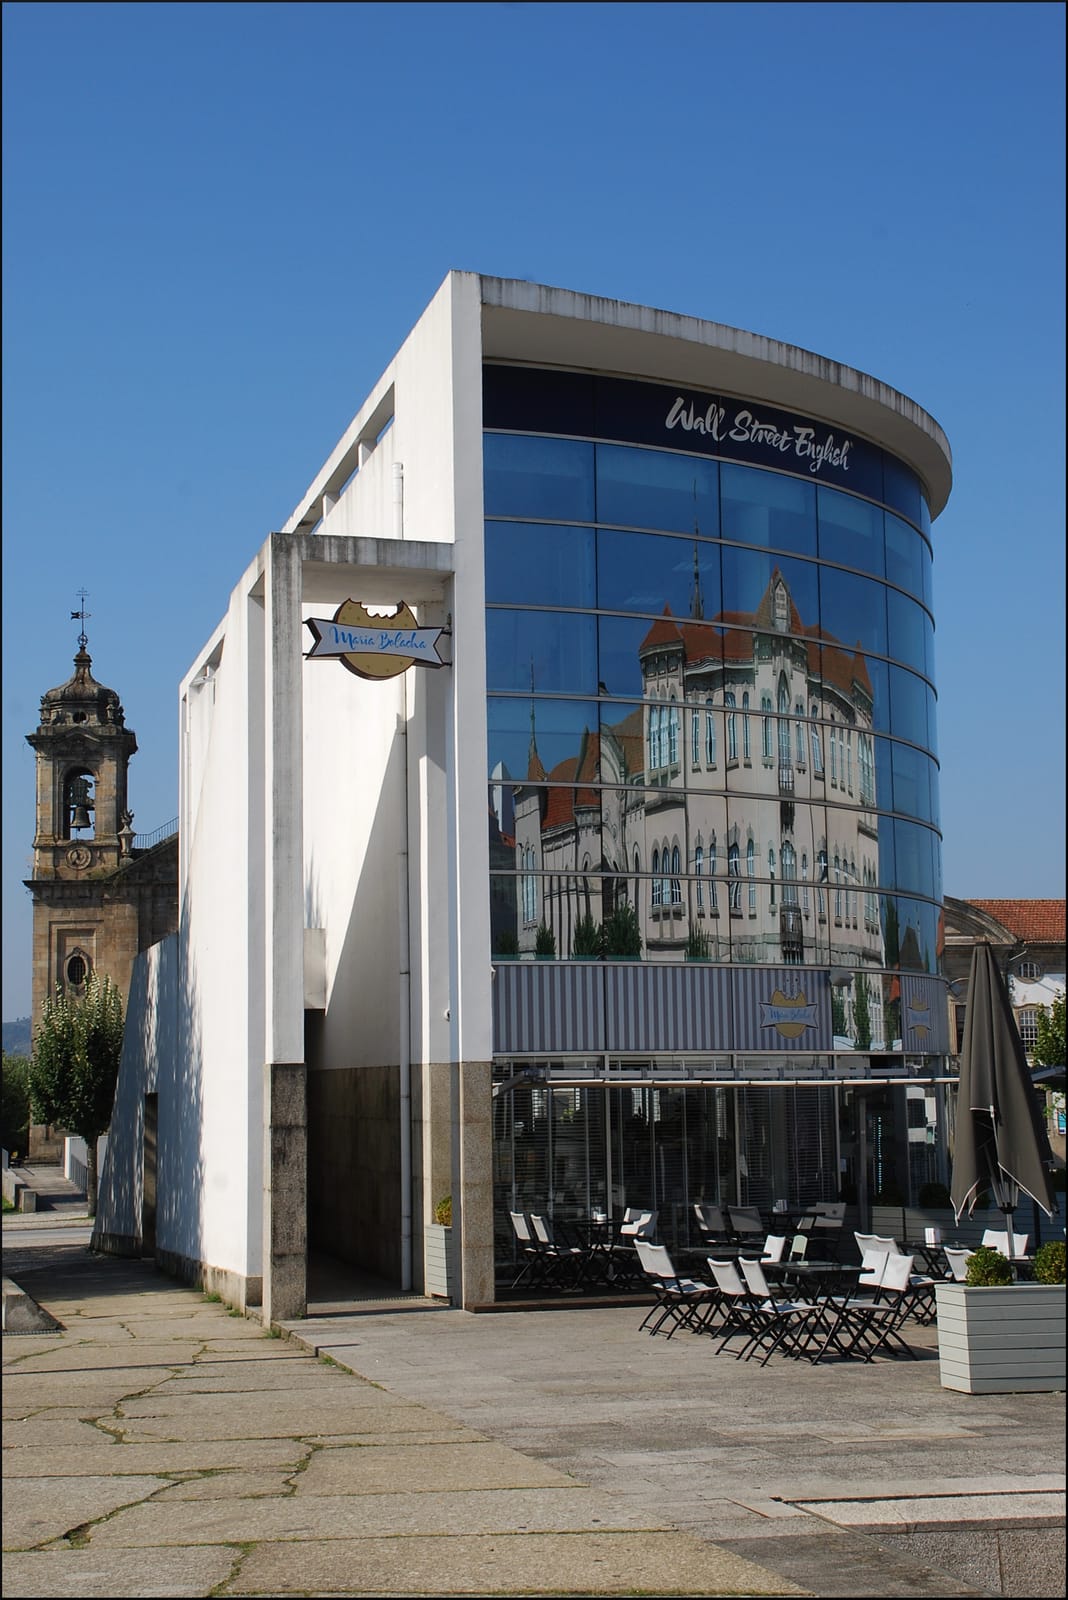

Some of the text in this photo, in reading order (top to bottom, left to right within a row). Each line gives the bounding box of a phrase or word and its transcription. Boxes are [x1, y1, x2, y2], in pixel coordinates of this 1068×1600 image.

[665, 397, 849, 472] Wall Street English
[329, 625, 426, 650] Maria Bolacha
